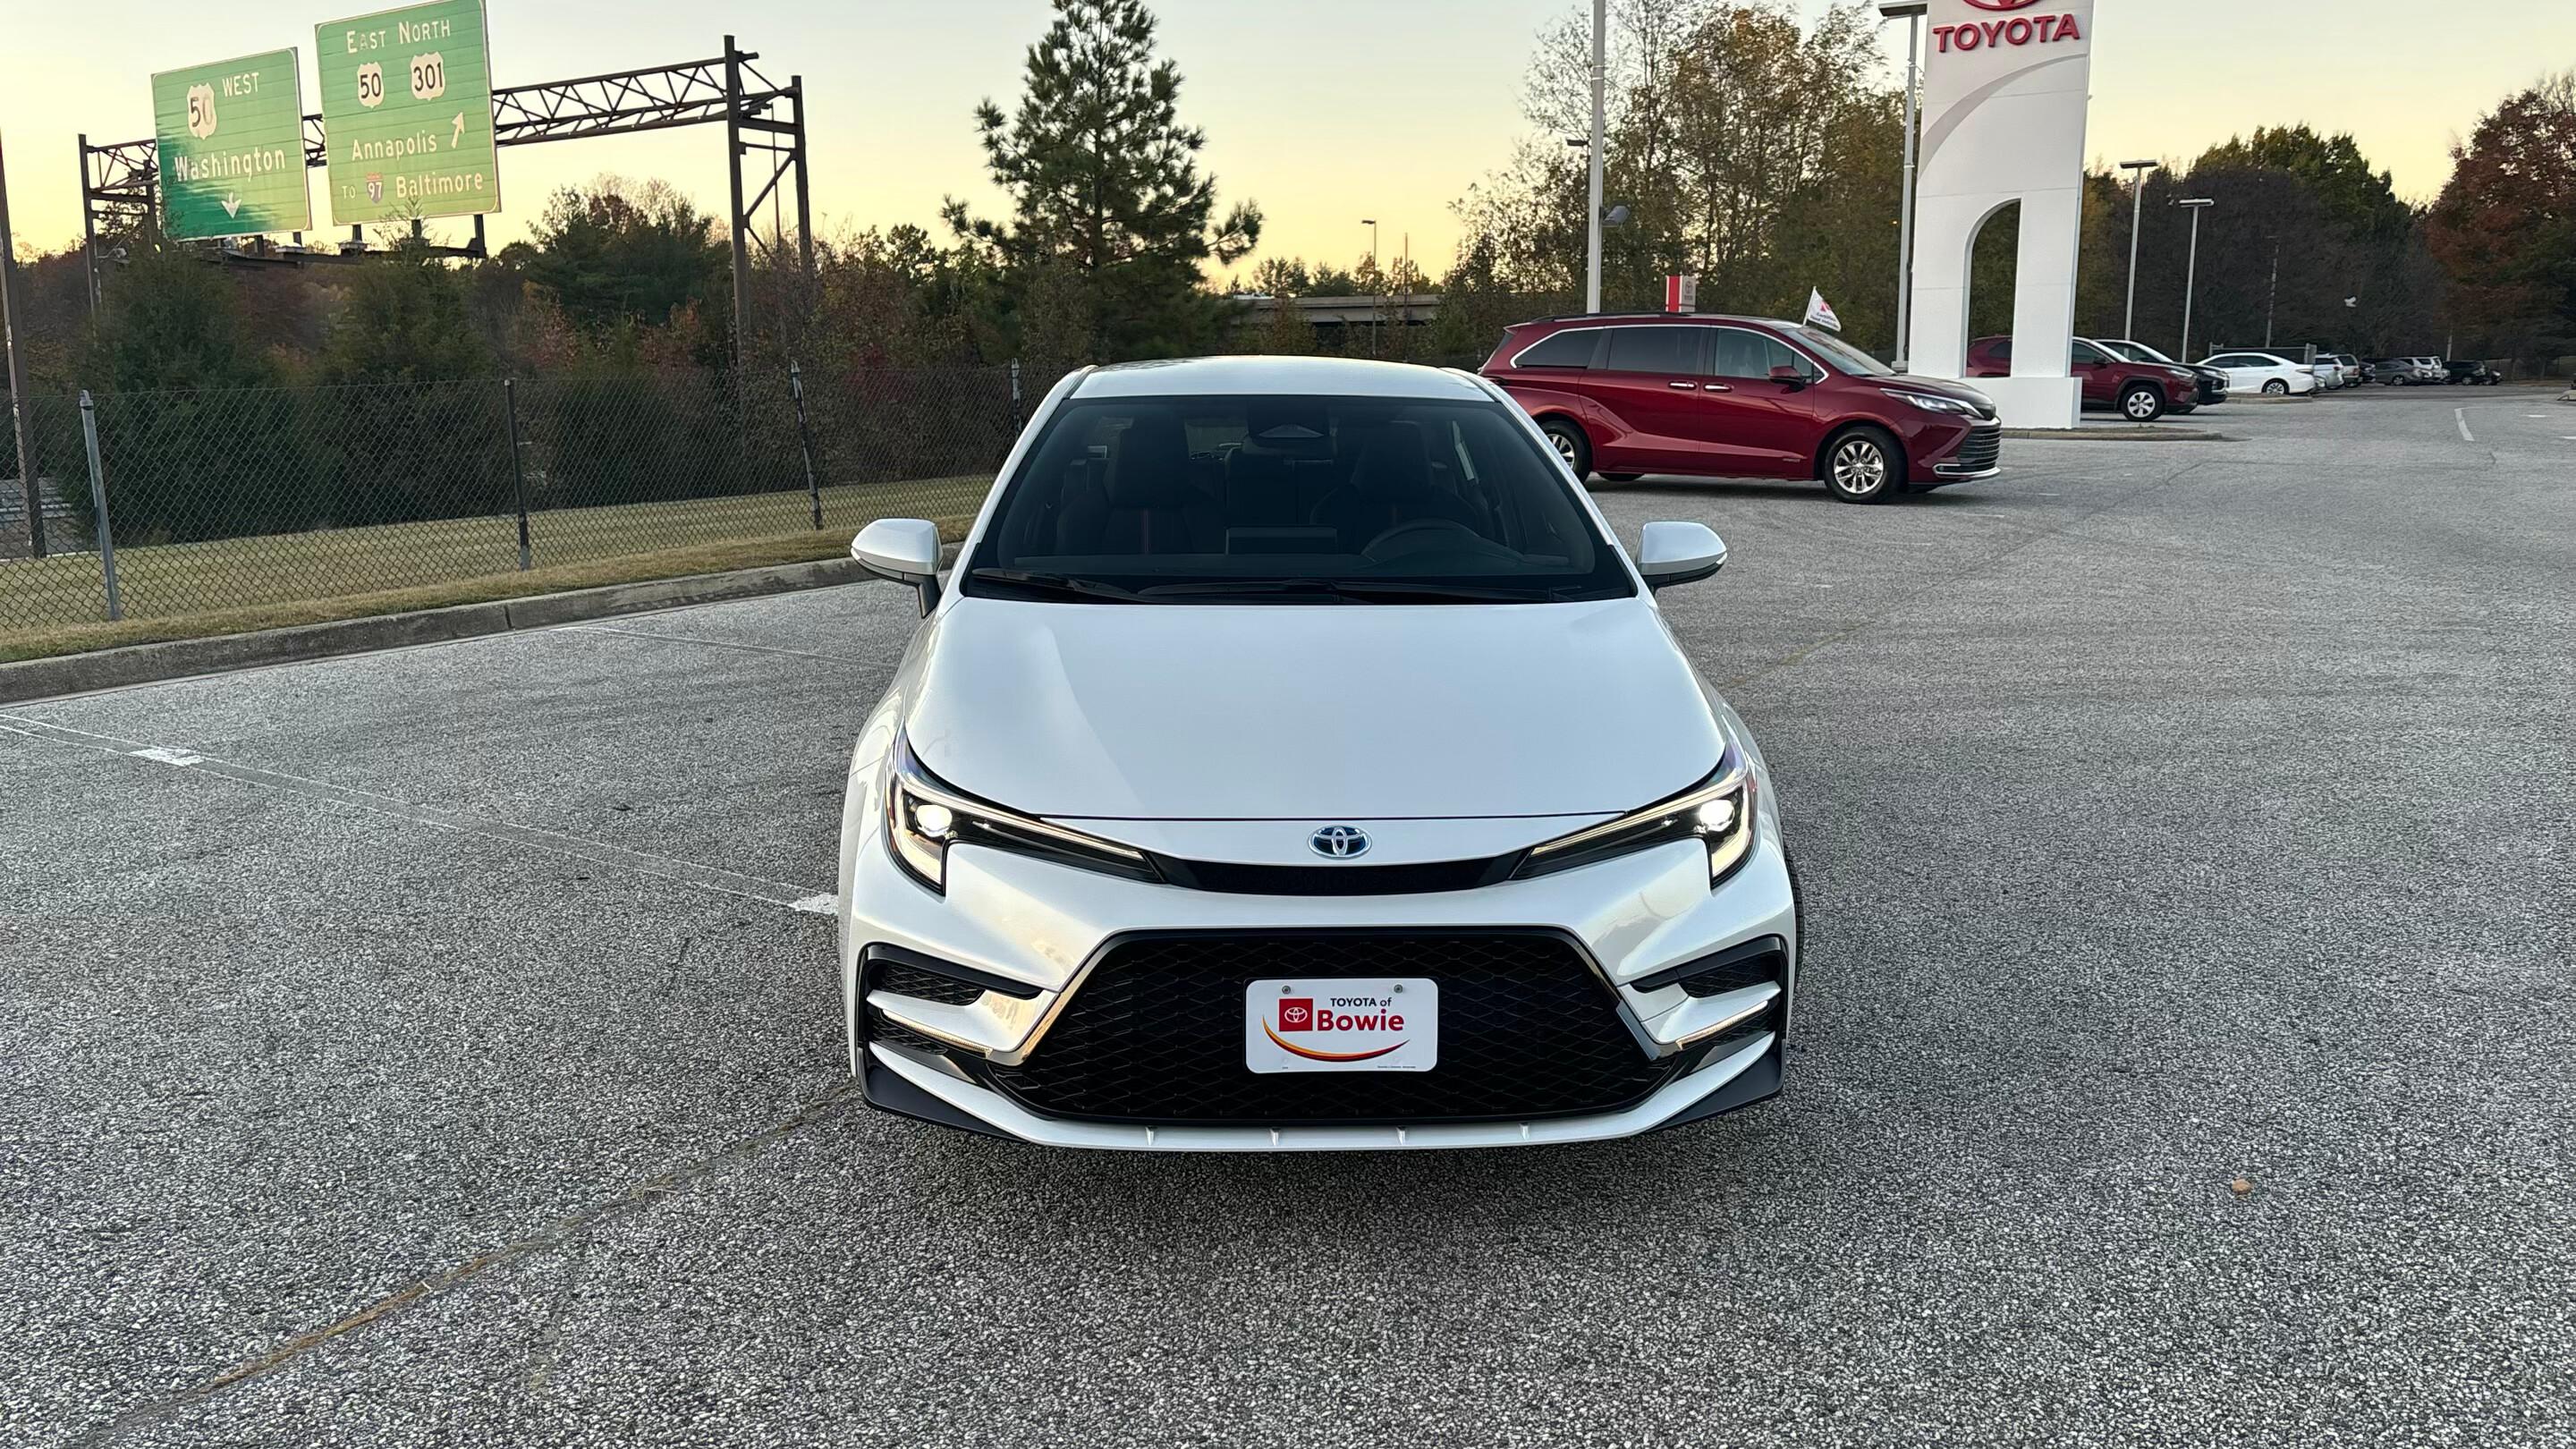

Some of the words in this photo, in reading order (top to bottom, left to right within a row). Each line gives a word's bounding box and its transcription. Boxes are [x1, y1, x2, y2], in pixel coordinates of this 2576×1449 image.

[346, 30, 386, 54] EAST
[399, 19, 450, 45] NORTH
[1933, 13, 2080, 53] TOYOTA
[222, 72, 259, 97] WEST
[360, 72, 382, 99] 50
[413, 62, 444, 92] 301
[191, 93, 214, 128] 50
[352, 129, 437, 161] Annapolis
[174, 146, 285, 182] Washington
[342, 185, 356, 199] TO
[368, 182, 383, 199] 97
[395, 171, 483, 199] Baltimore
[1330, 997, 1377, 1007] TOYOTA
[1379, 997, 1393, 1007] of
[1318, 1009, 1405, 1031] Bowie
